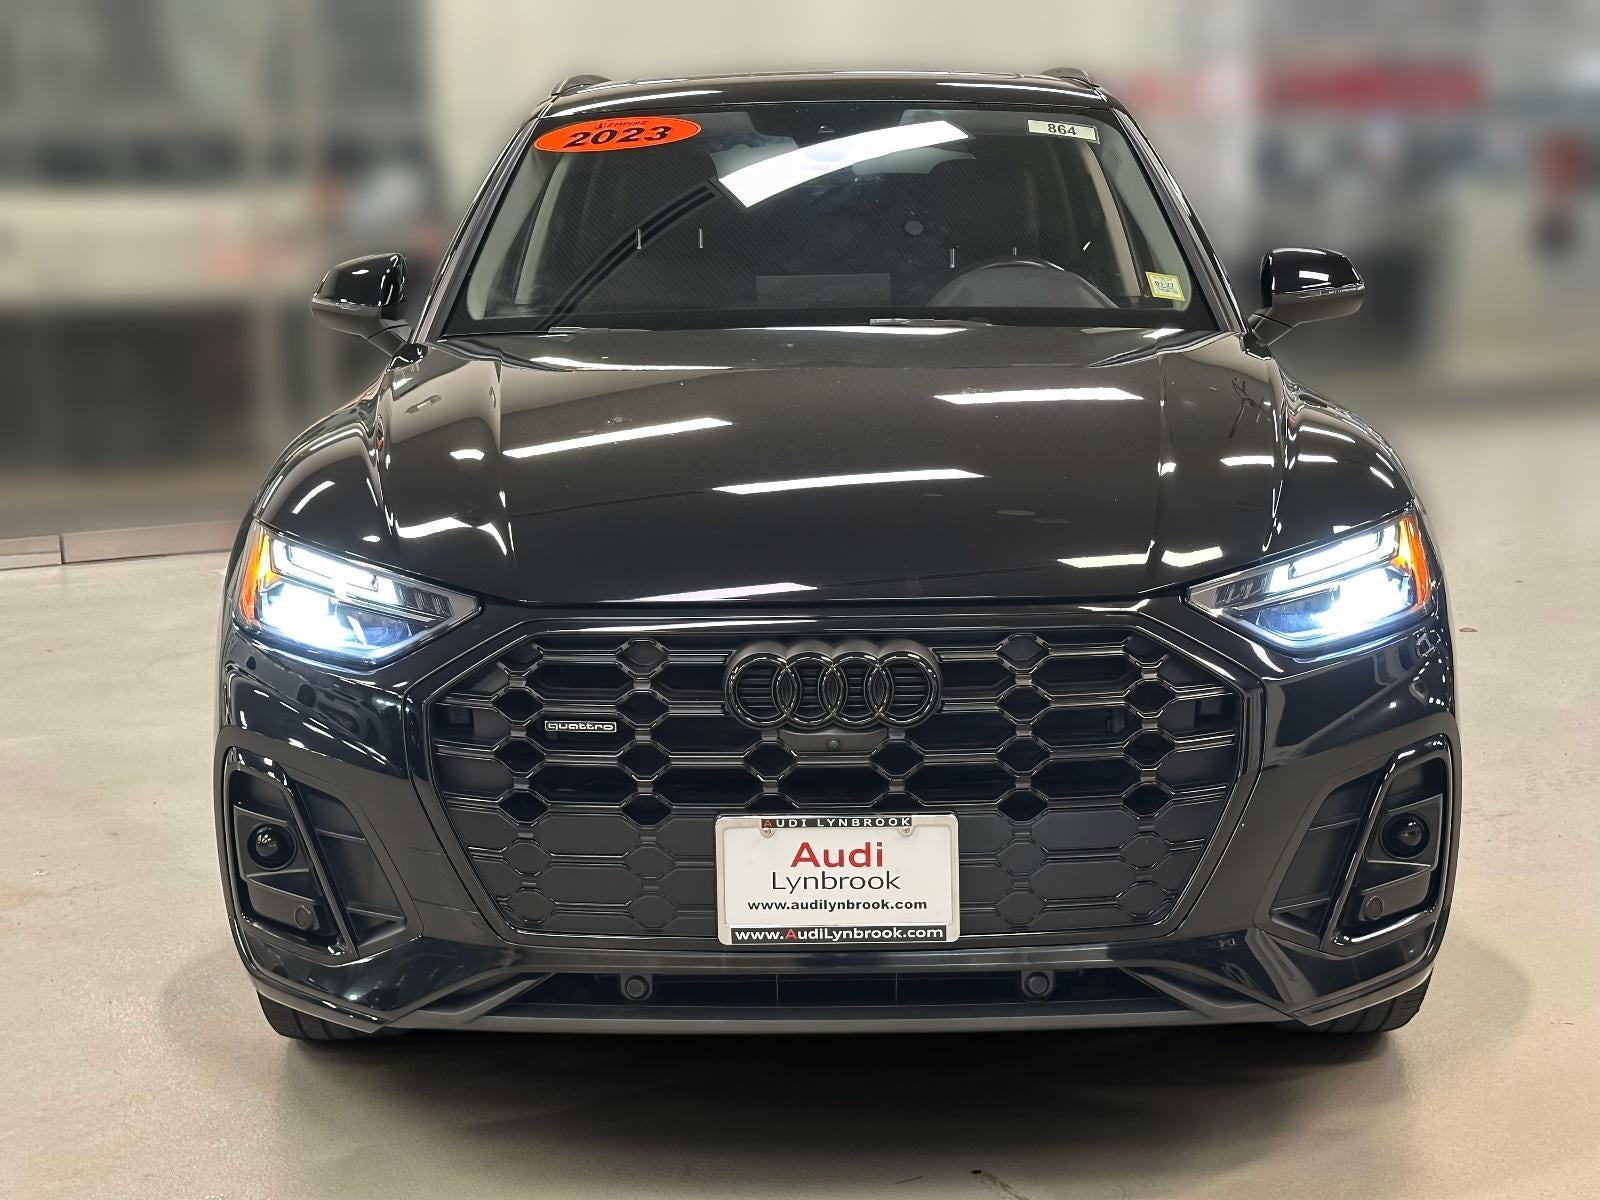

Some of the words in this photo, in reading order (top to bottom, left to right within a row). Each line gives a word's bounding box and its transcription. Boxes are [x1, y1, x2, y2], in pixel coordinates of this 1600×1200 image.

[1047, 123, 1077, 135] 864
[562, 126, 672, 148] 2023
[547, 722, 614, 731] quattro
[762, 818, 807, 828] AUDI
[817, 817, 911, 827] LYNBROOK
[790, 841, 883, 868] Audi
[771, 870, 901, 894] Lynbrook
[747, 899, 928, 912] www.audilynbrook.com
[735, 926, 943, 941] www.AudiLynbrook.com
